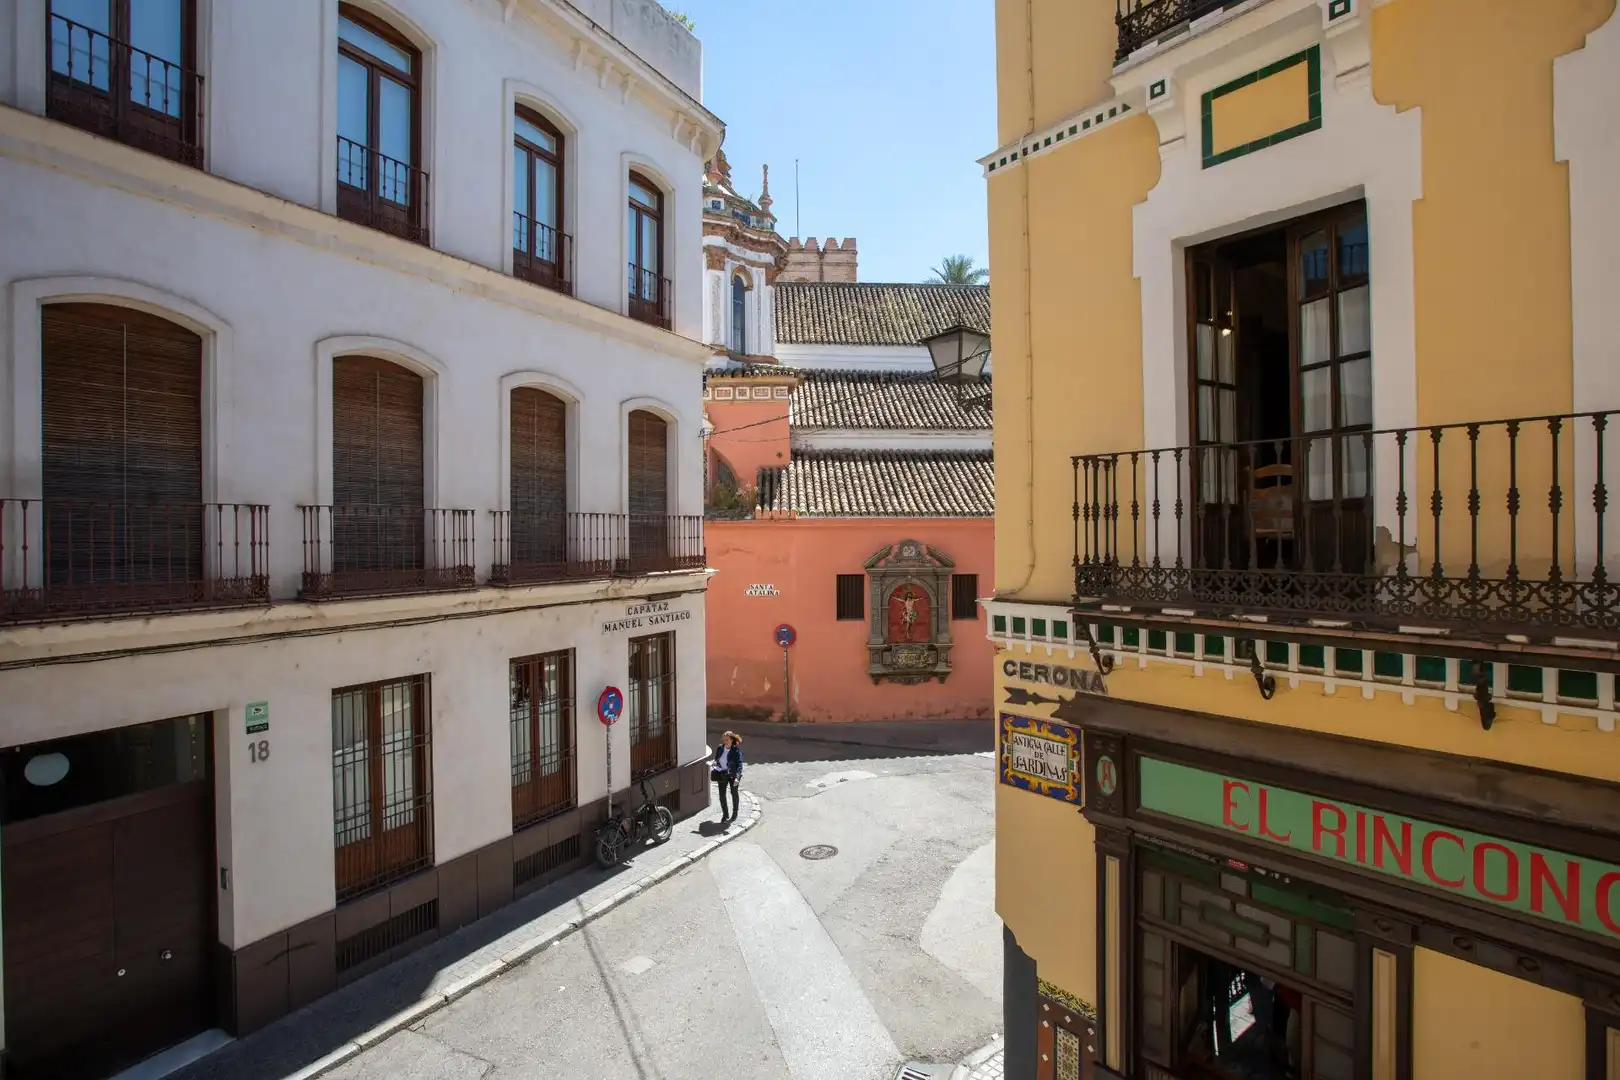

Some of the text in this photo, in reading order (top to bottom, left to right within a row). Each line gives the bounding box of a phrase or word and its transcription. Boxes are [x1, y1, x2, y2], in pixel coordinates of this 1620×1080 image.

[627, 602, 669, 616] CAPATAZ
[604, 619, 643, 632] MANUEL
[248, 740, 270, 763] 18
[1034, 751, 1044, 760] DE
[1043, 741, 1066, 756] CALLE
[1222, 779, 1292, 842] EL
